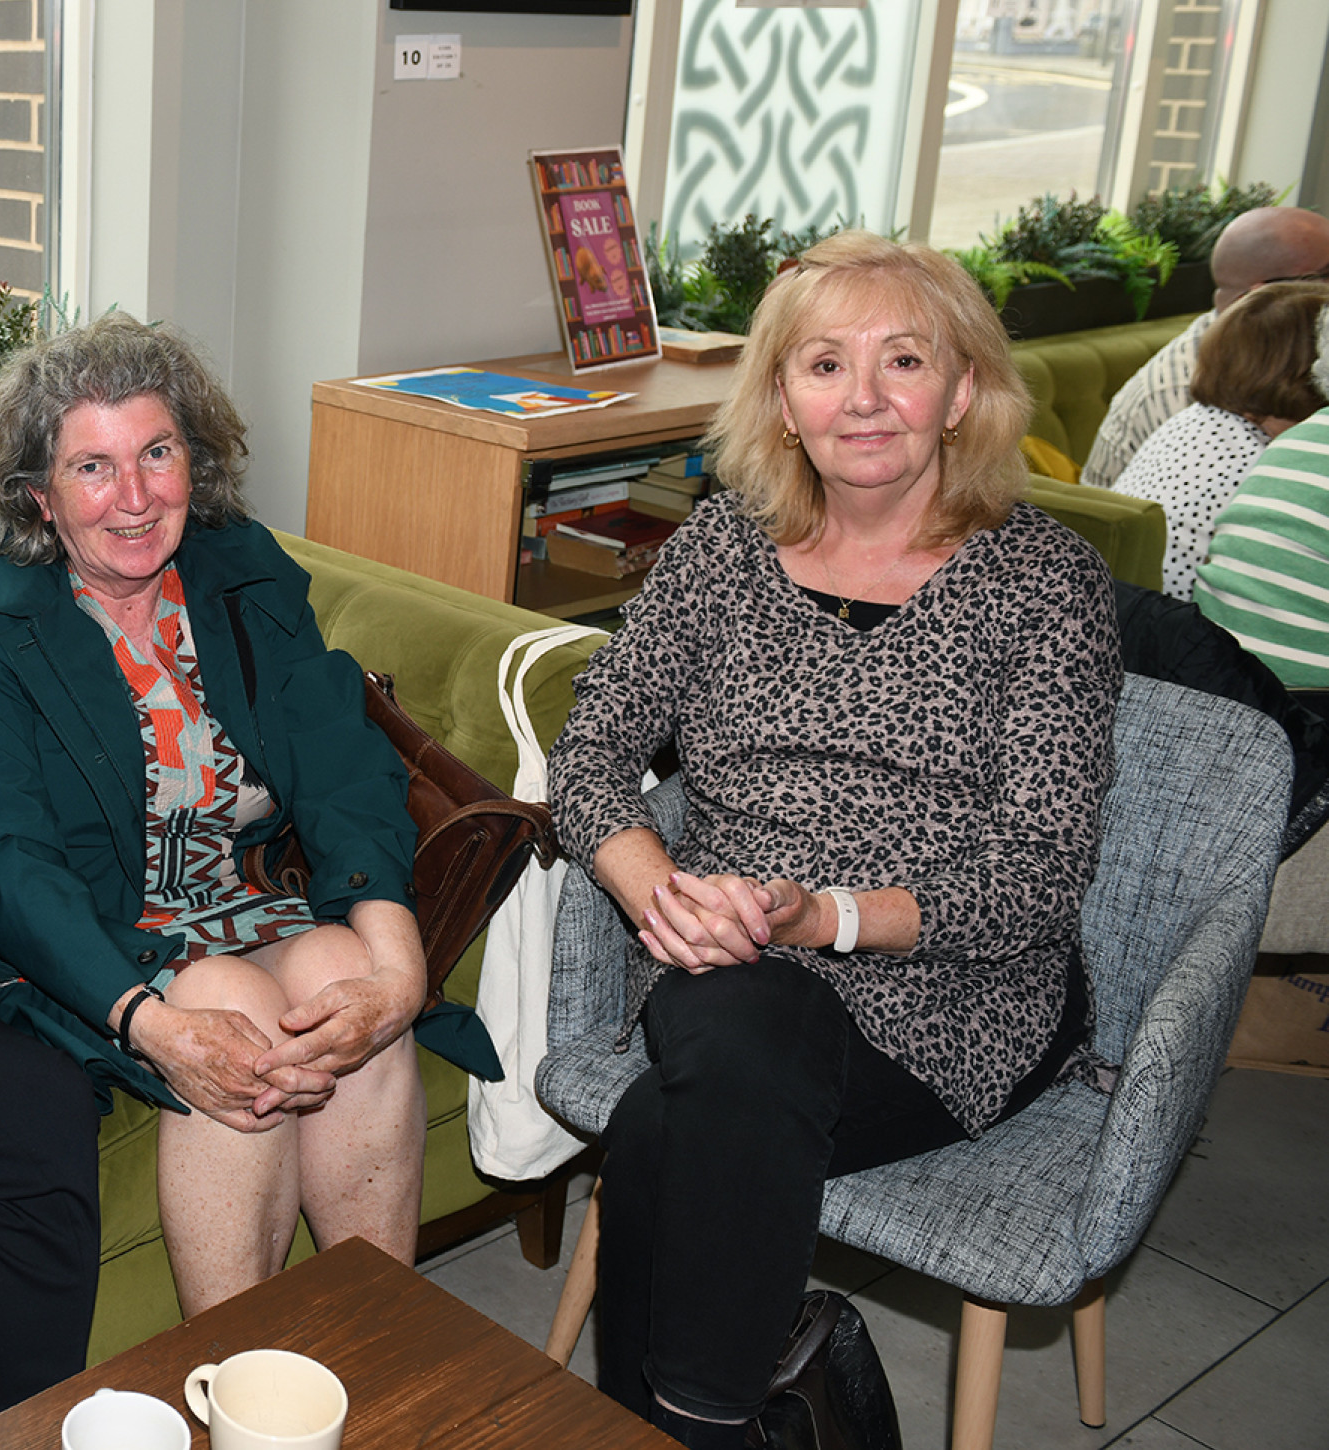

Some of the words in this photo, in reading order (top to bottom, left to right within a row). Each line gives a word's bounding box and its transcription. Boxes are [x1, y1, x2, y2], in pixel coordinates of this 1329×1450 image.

[402, 50, 421, 65] 10
[573, 199, 600, 211] BOOK
[571, 216, 612, 236] SALE
